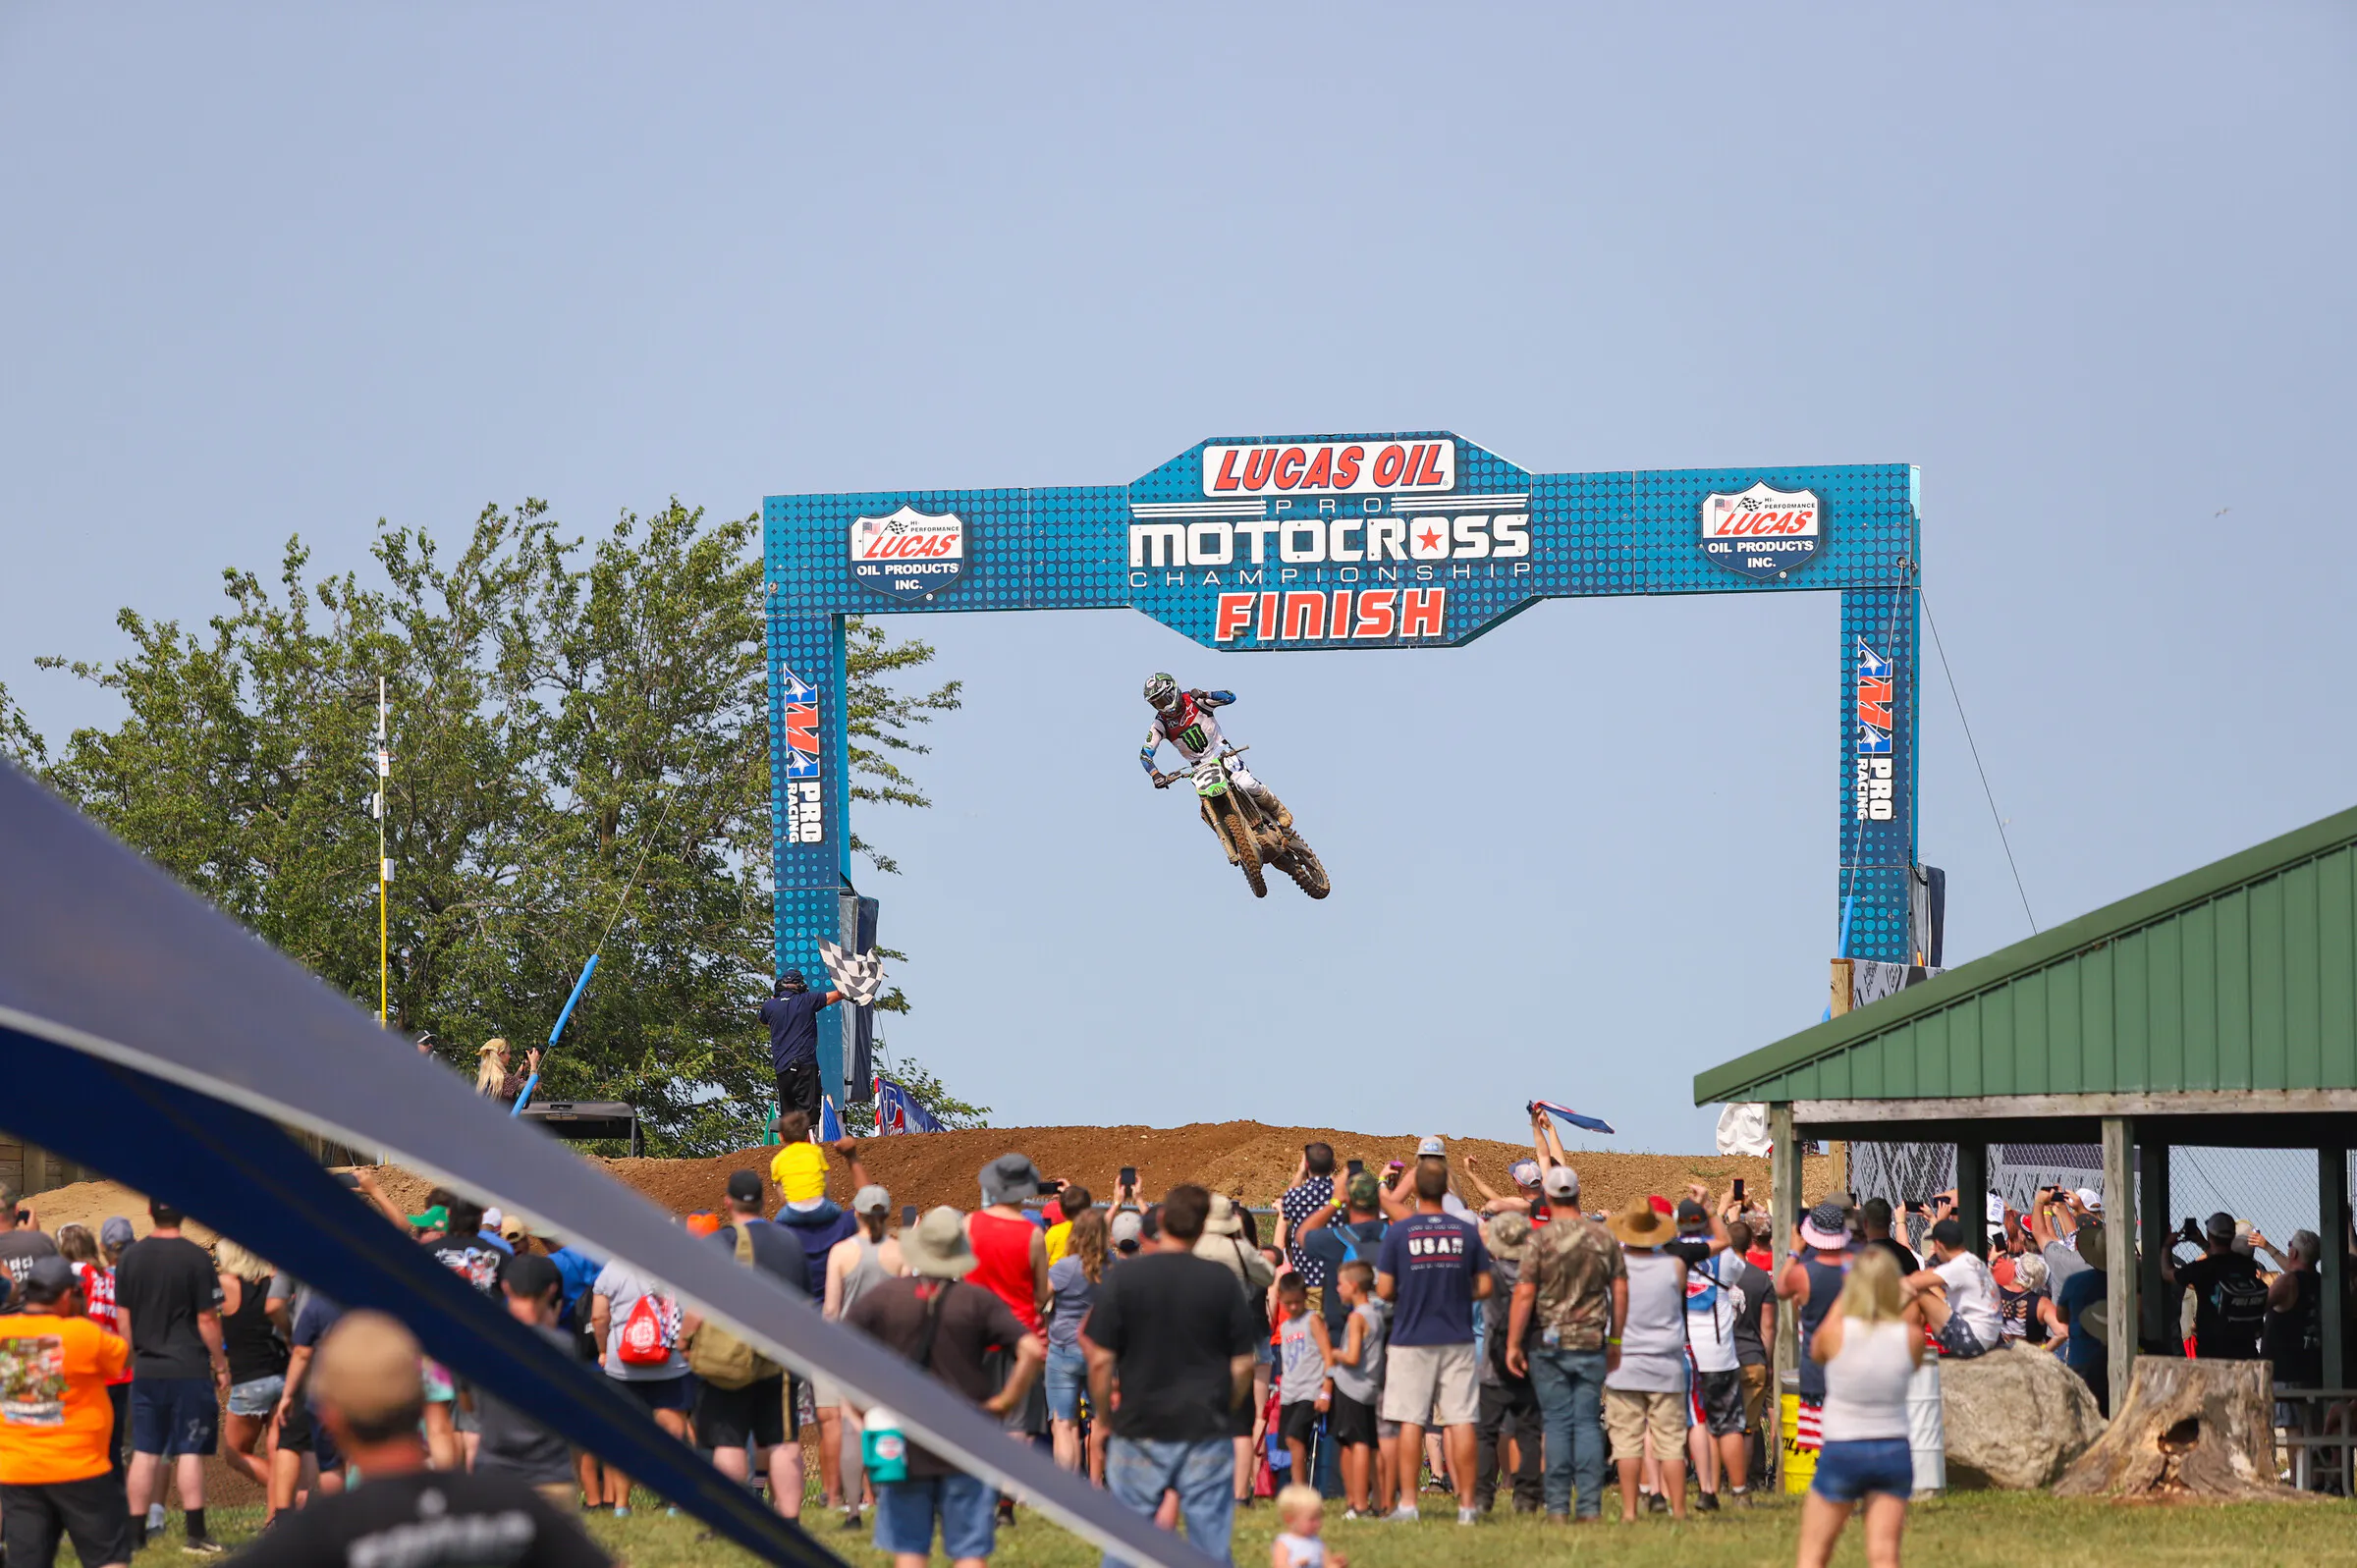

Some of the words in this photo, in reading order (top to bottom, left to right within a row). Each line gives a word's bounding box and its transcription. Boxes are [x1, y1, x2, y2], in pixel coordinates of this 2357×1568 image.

[1213, 445, 1364, 491] LUCAS
[1372, 444, 1445, 487] OIL
[1277, 497, 1382, 514] PRO
[1716, 511, 1813, 535] LUCAS
[863, 533, 958, 558] LUCAS
[1129, 514, 1529, 567] MOTOCROSS
[1708, 542, 1732, 553] OIL
[1736, 540, 1814, 552] PRODUCTS
[856, 565, 881, 576] OIL
[885, 563, 959, 575] PRODUCTS
[1129, 562, 1531, 588] CHAMPIONSHIP
[1747, 557, 1777, 568] INC.
[895, 579, 923, 590] INC.
[1214, 587, 1446, 642] FINISH
[1196, 768, 1221, 790] 3
[1857, 758, 1869, 821] RACING
[1869, 758, 1892, 820] PRO
[787, 783, 799, 843] RACING
[798, 782, 822, 843] PRO
